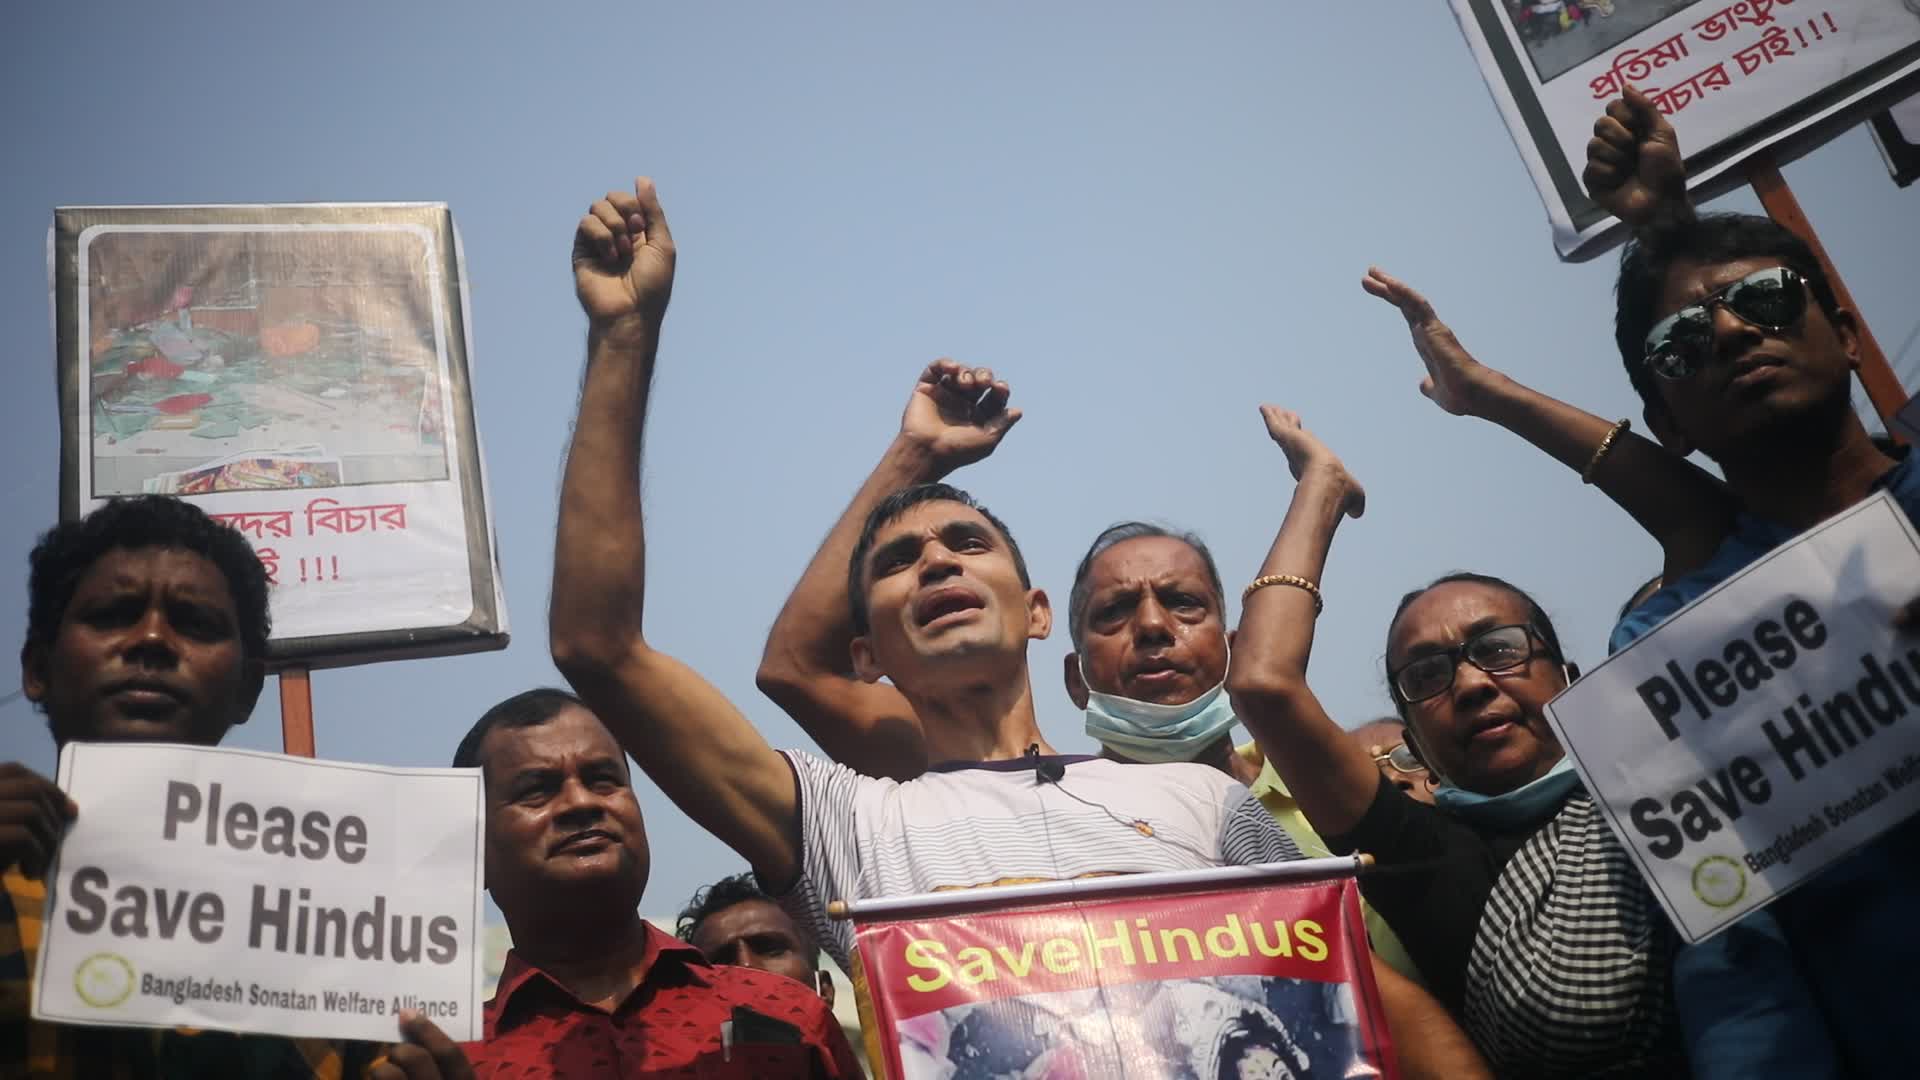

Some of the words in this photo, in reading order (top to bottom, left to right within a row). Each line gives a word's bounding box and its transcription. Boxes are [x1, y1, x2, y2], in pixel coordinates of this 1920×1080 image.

[304, 498, 408, 536] বিচার
[1636, 598, 1828, 741] Please
[163, 780, 368, 864] Please
[1629, 755, 1772, 861] Save
[1743, 814, 1828, 874] Bangladesh
[65, 866, 225, 944] Save
[248, 884, 459, 964] Hindus
[141, 973, 243, 1005] Bangladesh
[249, 983, 317, 1012] Sonatan
[323, 991, 386, 1016] Welfare
